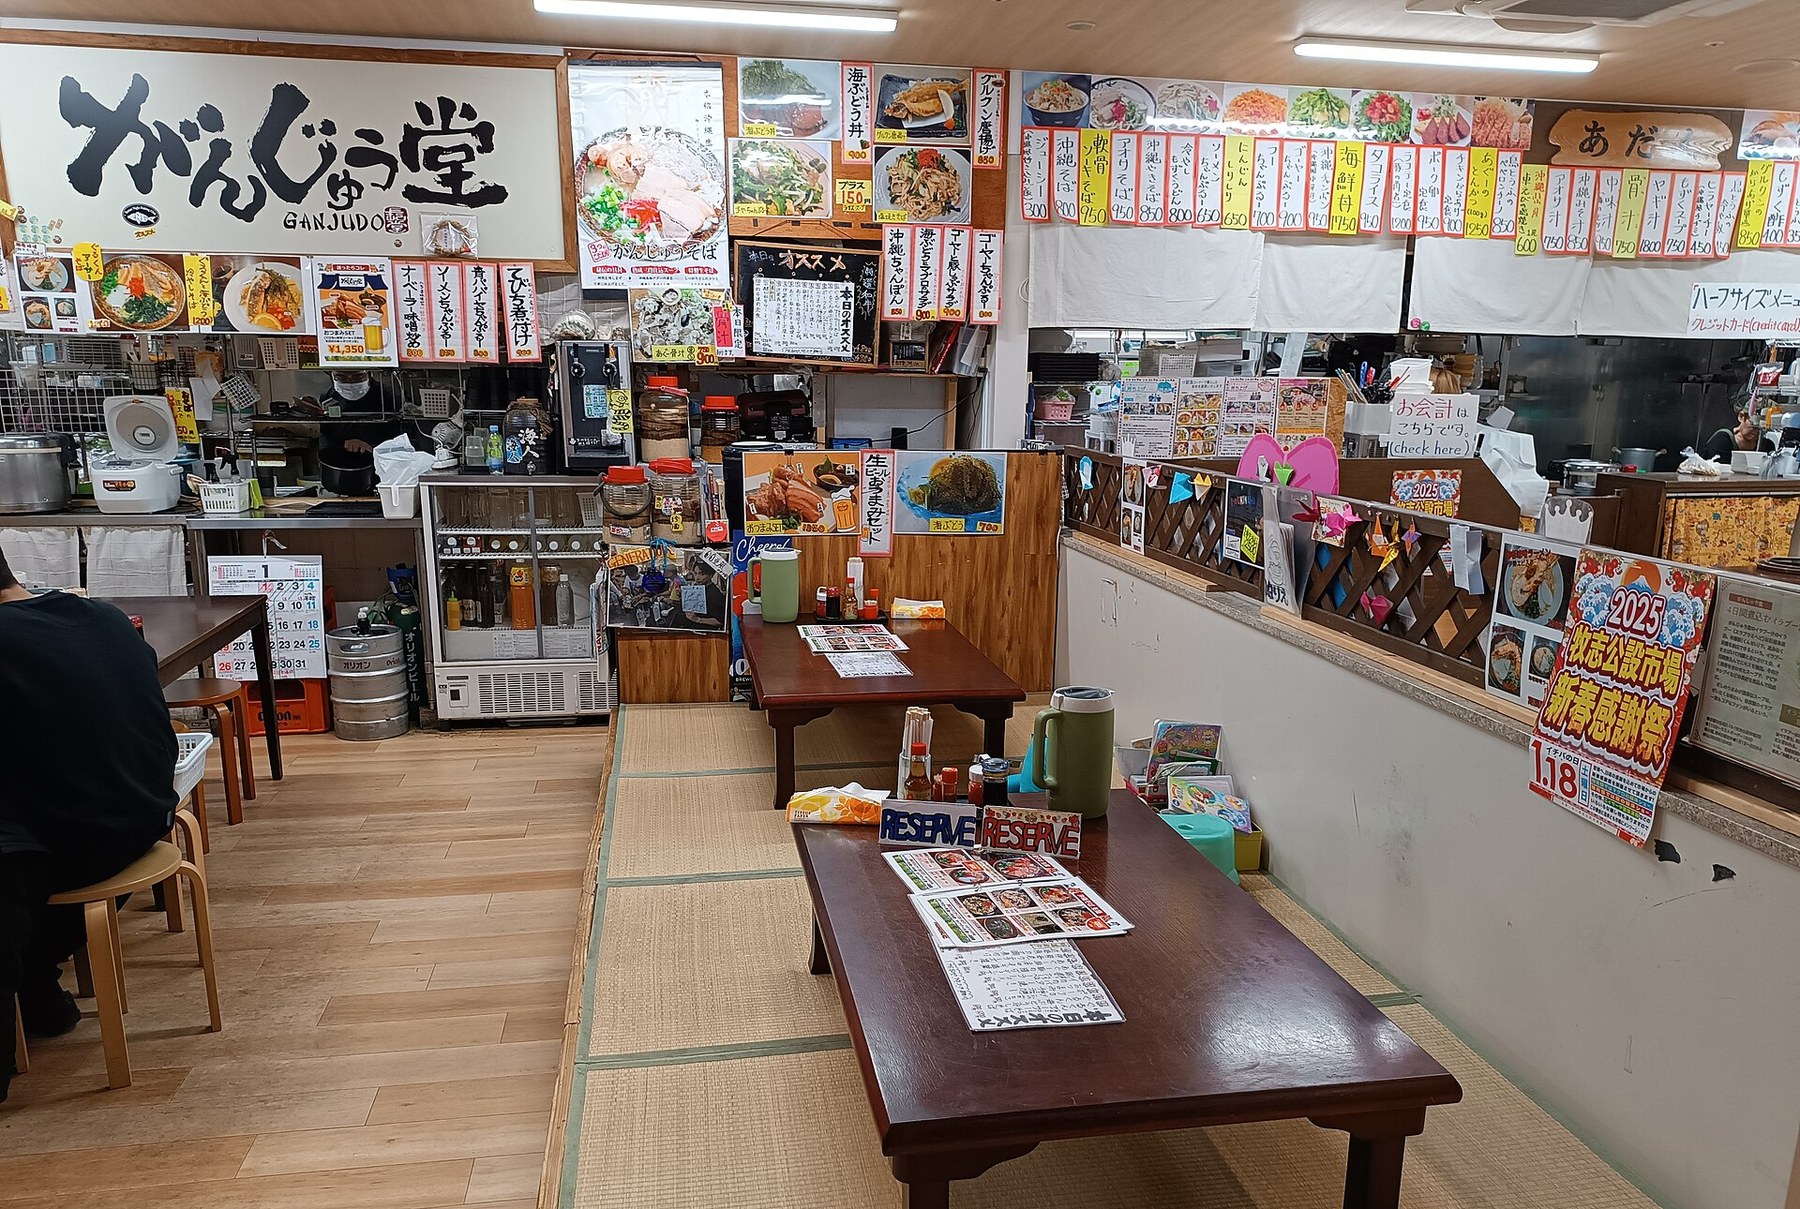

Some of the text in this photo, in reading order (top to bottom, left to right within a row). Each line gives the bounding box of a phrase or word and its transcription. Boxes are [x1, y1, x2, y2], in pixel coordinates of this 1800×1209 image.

[847, 67, 867, 139] 海ぶどう丼
[977, 74, 997, 155] グルクン唐揚げ
[58, 73, 508, 222] がんじゅう堂
[848, 151, 867, 160] 900
[1093, 133, 1109, 175] 軟骨
[977, 156, 994, 165] 850
[1036, 136, 1049, 198] ジューシー
[1056, 136, 1077, 193] 沖縄そば
[1211, 143, 1221, 182] ソーメン
[1238, 142, 1248, 187] にんじん
[1081, 145, 1096, 204] ソーキそば
[1226, 160, 1234, 202] しりしり
[1337, 146, 1361, 213] 海鮮丼
[1365, 149, 1384, 207] タコライス
[1481, 152, 1494, 198] あぐーの
[838, 181, 865, 190] プラス
[1468, 166, 1479, 206] とんかつ
[841, 190, 871, 204] 150円
[1601, 175, 1619, 229] 中味汁
[1622, 174, 1643, 231] 骨汁
[1647, 180, 1667, 230] ヤギ汁
[1673, 177, 1692, 234] もずくスープ
[1024, 202, 1047, 218] 300
[1055, 200, 1075, 218] 800
[1081, 205, 1107, 224] 950
[1112, 204, 1134, 219] 950
[1140, 204, 1163, 222] 850
[1169, 208, 1192, 222] 800
[1197, 208, 1220, 222] 650
[283, 211, 384, 232] GANJUDO
[1223, 213, 1247, 226] 650
[1253, 211, 1275, 226] 700
[1278, 211, 1302, 226] 900
[1308, 211, 1328, 228] 950
[1331, 215, 1357, 231] 1750
[1360, 212, 1379, 229] 950
[1392, 217, 1411, 230] 1200
[1417, 214, 1440, 230] 950
[1443, 218, 1463, 232] 900
[1492, 217, 1515, 234] 850
[1466, 223, 1489, 236] 1250
[1739, 230, 1760, 245] 850
[1516, 236, 1537, 253] 600
[1544, 235, 1564, 249] 750
[1566, 234, 1589, 250] 850
[1615, 240, 1635, 254] 750
[1640, 239, 1661, 252] 1800
[1666, 238, 1685, 252] 750
[1690, 241, 1711, 254] 450
[91, 243, 103, 275] ぐるくん
[612, 242, 719, 261] がんじゅうそば
[75, 258, 85, 272] そば
[82, 253, 93, 280] アーサー
[778, 250, 847, 272] オススメ
[887, 228, 906, 306] 沖縄ちゃんぽん
[401, 264, 421, 348] ナーベーラー味噌炒め
[506, 267, 533, 347] てびち煮付け
[942, 309, 961, 317] 900
[733, 306, 743, 349] 本日限定
[840, 286, 854, 352] 本日のオススメ
[328, 345, 364, 355] ¥1,350
[1397, 397, 1469, 419] お会計は
[1398, 422, 1469, 438] こちらです。
[518, 428, 539, 458] 海人
[1389, 440, 1470, 457] (check here)
[1412, 483, 1439, 498] 2025
[865, 454, 891, 546] 生ビールおつまみセット
[933, 520, 964, 530] 海ぶどう
[262, 565, 269, 578] 1
[292, 582, 299, 590] 3
[307, 601, 316, 609] 11
[1608, 589, 1663, 635] 2025
[278, 621, 289, 629] 16
[293, 621, 303, 629] 17
[233, 643, 244, 651] 20
[279, 641, 291, 649] 23
[309, 640, 320, 648] 25
[219, 663, 231, 671] 26
[235, 662, 246, 670] 27
[280, 660, 292, 668] 30
[343, 661, 371, 670] オリオン
[404, 632, 420, 702] オリオンビール
[1568, 623, 1683, 695] 牧志公設市場
[1543, 672, 1671, 764] 新春感謝祭
[1546, 746, 1580, 766] イチバの日
[1531, 739, 1578, 799] 1.18
[1581, 765, 1589, 801] 土曜日
[880, 808, 976, 847] RESERVE
[982, 817, 1079, 856] RESERVE
[977, 1009, 1112, 1028] 本日のオススメ
